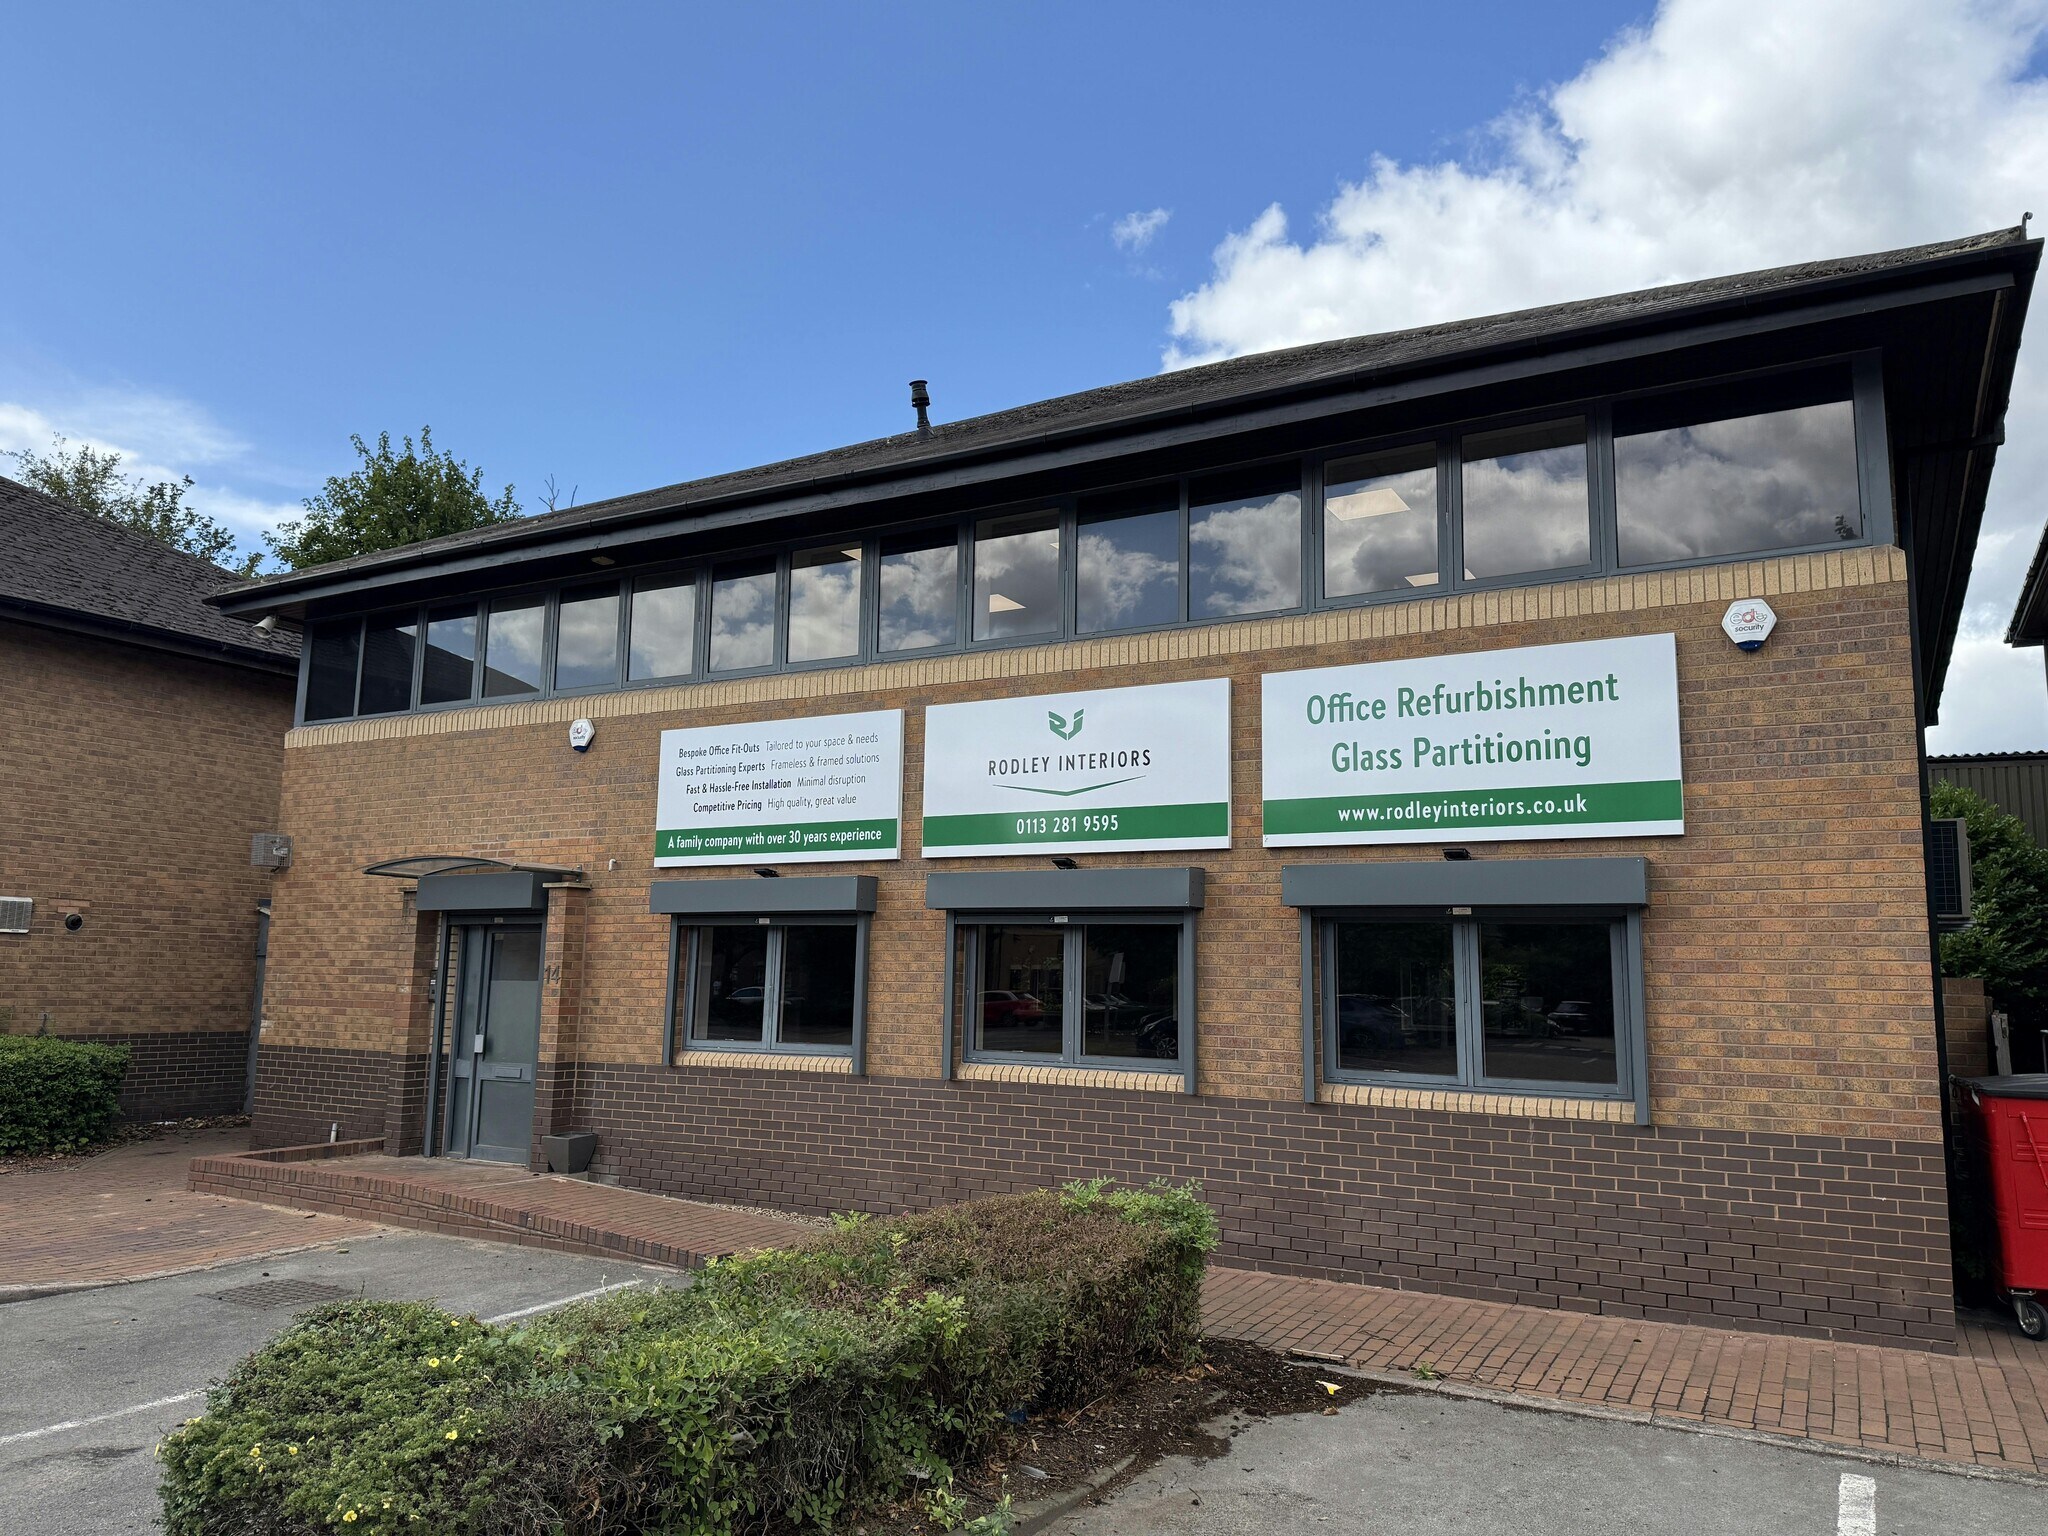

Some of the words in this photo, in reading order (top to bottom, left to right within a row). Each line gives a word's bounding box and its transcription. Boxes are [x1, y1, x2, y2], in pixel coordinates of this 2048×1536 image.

[1306, 692, 1387, 725] Office
[1397, 673, 1619, 718] Refurbishment
[679, 747, 707, 759] Bespoke
[709, 745, 729, 756] Office
[731, 743, 760, 754] Fit-Outs
[766, 739, 793, 751] Tailored
[796, 740, 803, 749] to
[806, 740, 821, 750] your
[824, 737, 845, 748] space
[847, 734, 853, 744] &
[855, 733, 879, 744] needs
[1331, 742, 1402, 773] Glass
[1413, 728, 1592, 767] Partitioning
[676, 766, 694, 777] Glass
[695, 764, 736, 775] Partitioning
[738, 762, 765, 774] Experts
[771, 758, 806, 770] Frameless
[809, 756, 815, 767] &
[817, 754, 843, 766] framed
[846, 753, 880, 765] solutions
[988, 756, 1050, 776] RODLEY
[1058, 749, 1151, 772] INTERIORS
[686, 784, 700, 794] Fast
[702, 783, 707, 793] &
[709, 781, 750, 793] Hassle-Free
[752, 778, 792, 790] Installation
[797, 775, 826, 787] Minimal
[828, 773, 866, 787] disruption
[693, 801, 735, 814] Competitive
[737, 800, 762, 811] Pricing
[768, 797, 784, 810] High
[786, 797, 813, 809] quality,
[815, 797, 834, 808] great
[837, 794, 857, 805] value
[1338, 793, 1588, 822] www.rodleyinteriors.co.uk
[1016, 818, 1047, 834] 0113
[1053, 816, 1077, 833] 281
[1083, 814, 1119, 832] 9595
[668, 836, 674, 848] A
[677, 835, 702, 851] family
[704, 836, 743, 849] company
[745, 832, 764, 845] with
[767, 834, 786, 844] over
[789, 830, 800, 843] 30
[803, 832, 827, 846] years
[830, 828, 882, 844] experience
[545, 964, 561, 985] 14
